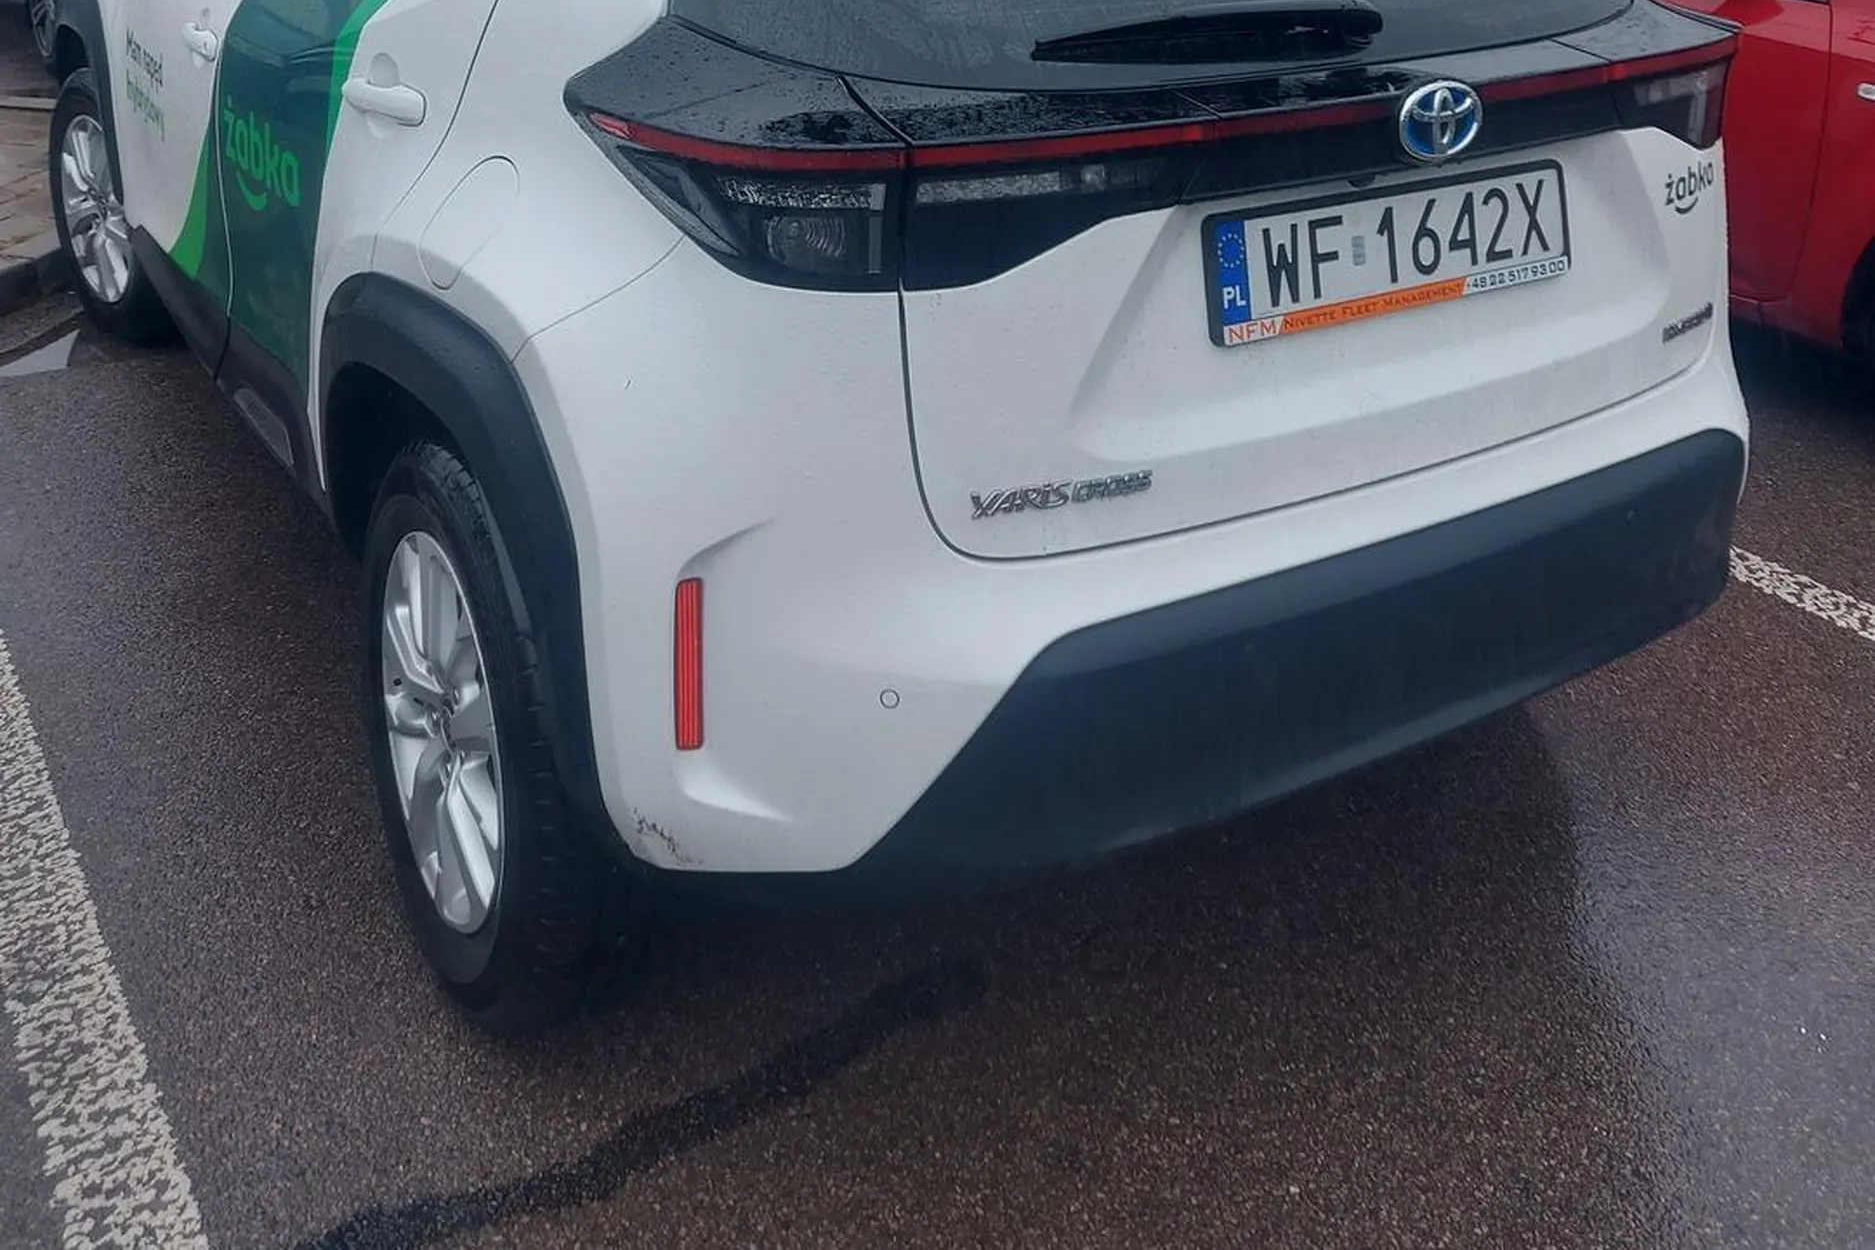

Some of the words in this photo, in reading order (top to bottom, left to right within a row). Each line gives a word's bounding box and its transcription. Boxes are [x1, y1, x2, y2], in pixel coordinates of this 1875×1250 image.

[224, 94, 299, 208] żabka
[1664, 161, 1714, 208] żabka
[1262, 215, 1343, 307] WF
[1377, 178, 1550, 284] 1642X
[1222, 285, 1247, 309] PL
[1284, 310, 1337, 330] NIVETTE
[1341, 300, 1379, 317] FLEET
[1383, 282, 1462, 307] MANAGEMENT
[1228, 319, 1278, 344] NFM
[971, 478, 1073, 519] YARIS
